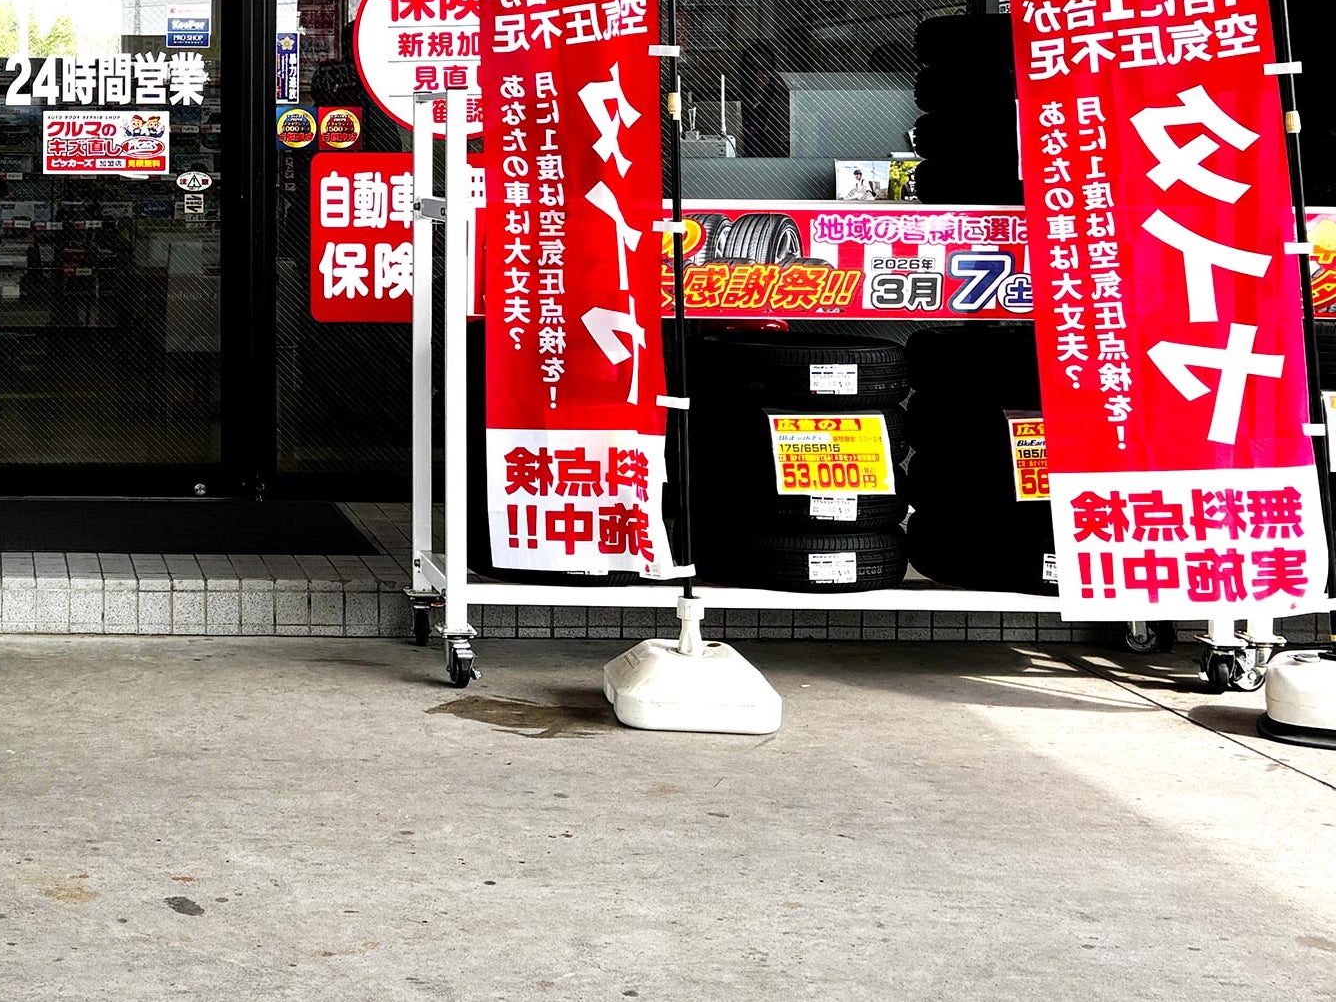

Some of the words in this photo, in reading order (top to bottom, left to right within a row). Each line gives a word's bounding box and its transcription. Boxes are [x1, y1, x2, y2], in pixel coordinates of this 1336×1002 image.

[5, 51, 205, 106] 24時間営業
[47, 121, 117, 137] クルマの
[48, 139, 122, 156] キズ直し
[873, 258, 934, 271] 2026年
[662, 264, 861, 309] 感謝祭!!
[779, 443, 840, 453] 175/65R15
